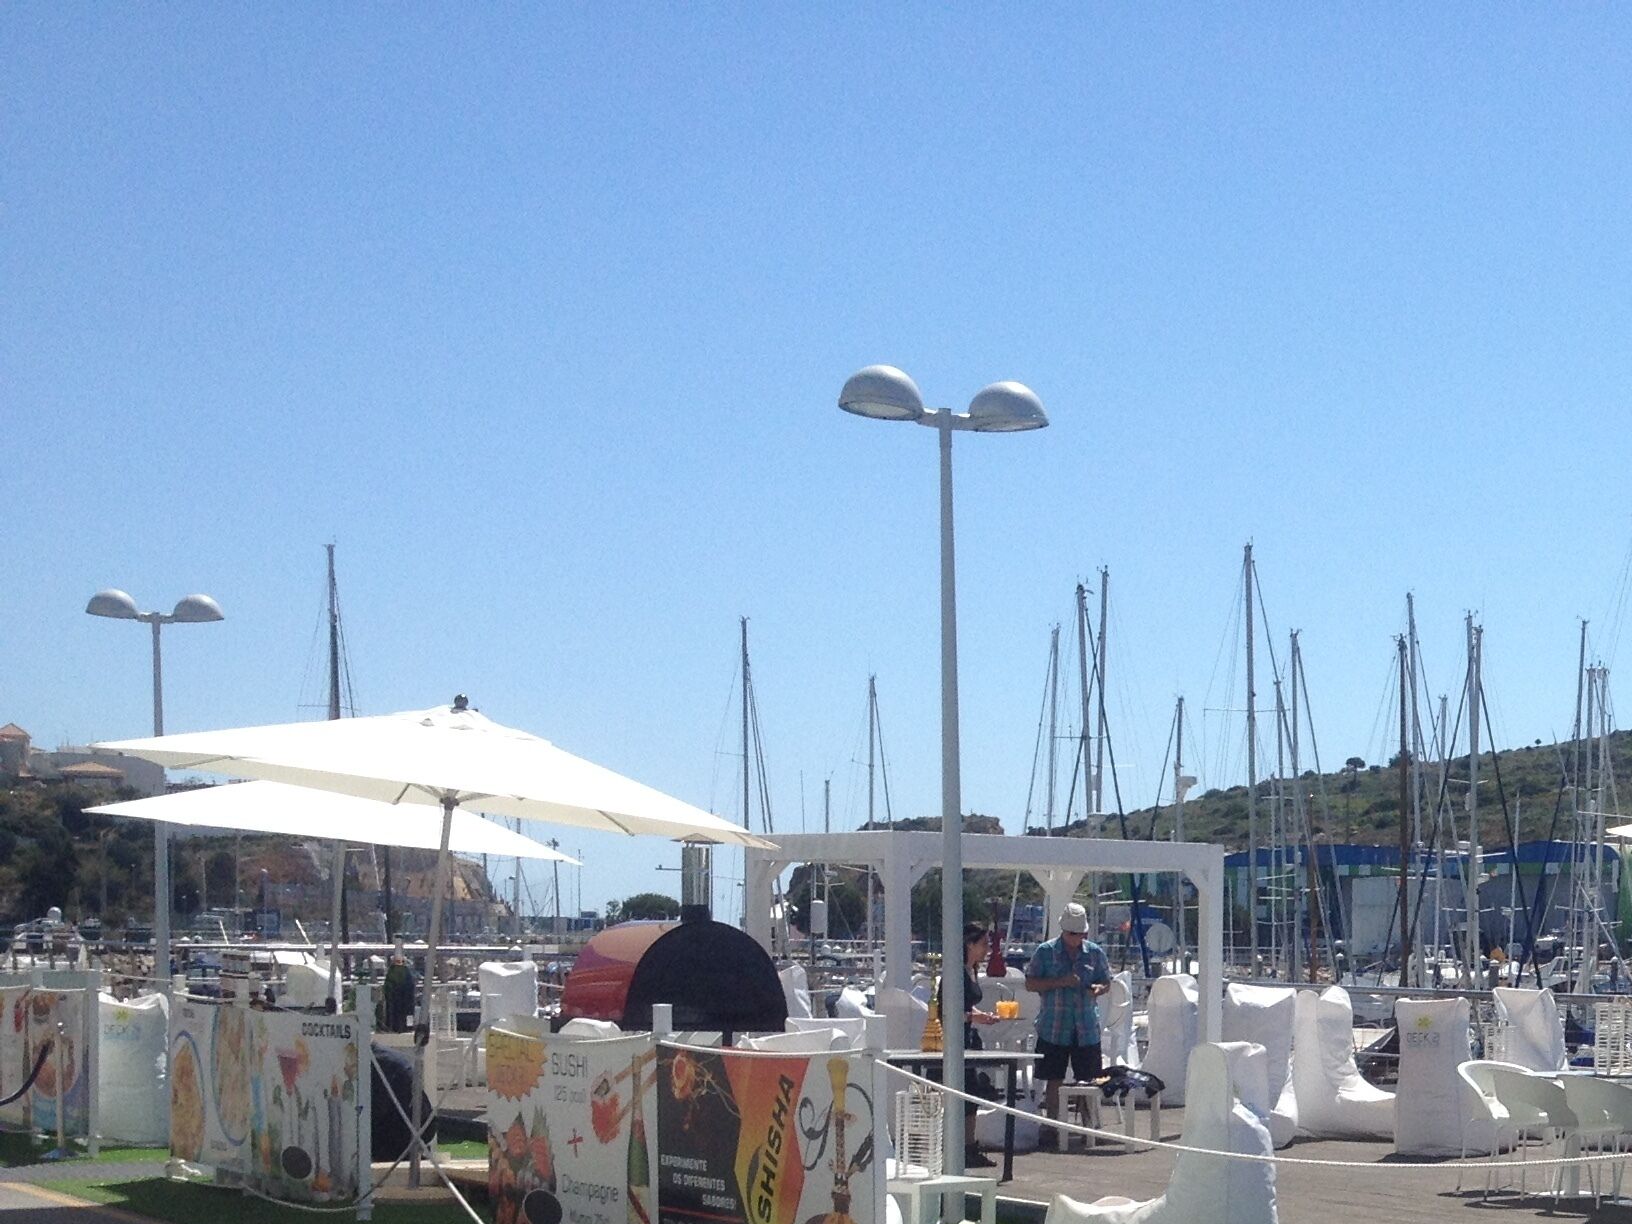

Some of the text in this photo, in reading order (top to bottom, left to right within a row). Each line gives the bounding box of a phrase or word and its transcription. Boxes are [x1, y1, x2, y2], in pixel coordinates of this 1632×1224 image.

[301, 1022, 351, 1040] COCKTAILS
[552, 1052, 588, 1078] SUSHI
[757, 1073, 795, 1224] SHISHA
[562, 1173, 619, 1205] Champagne
